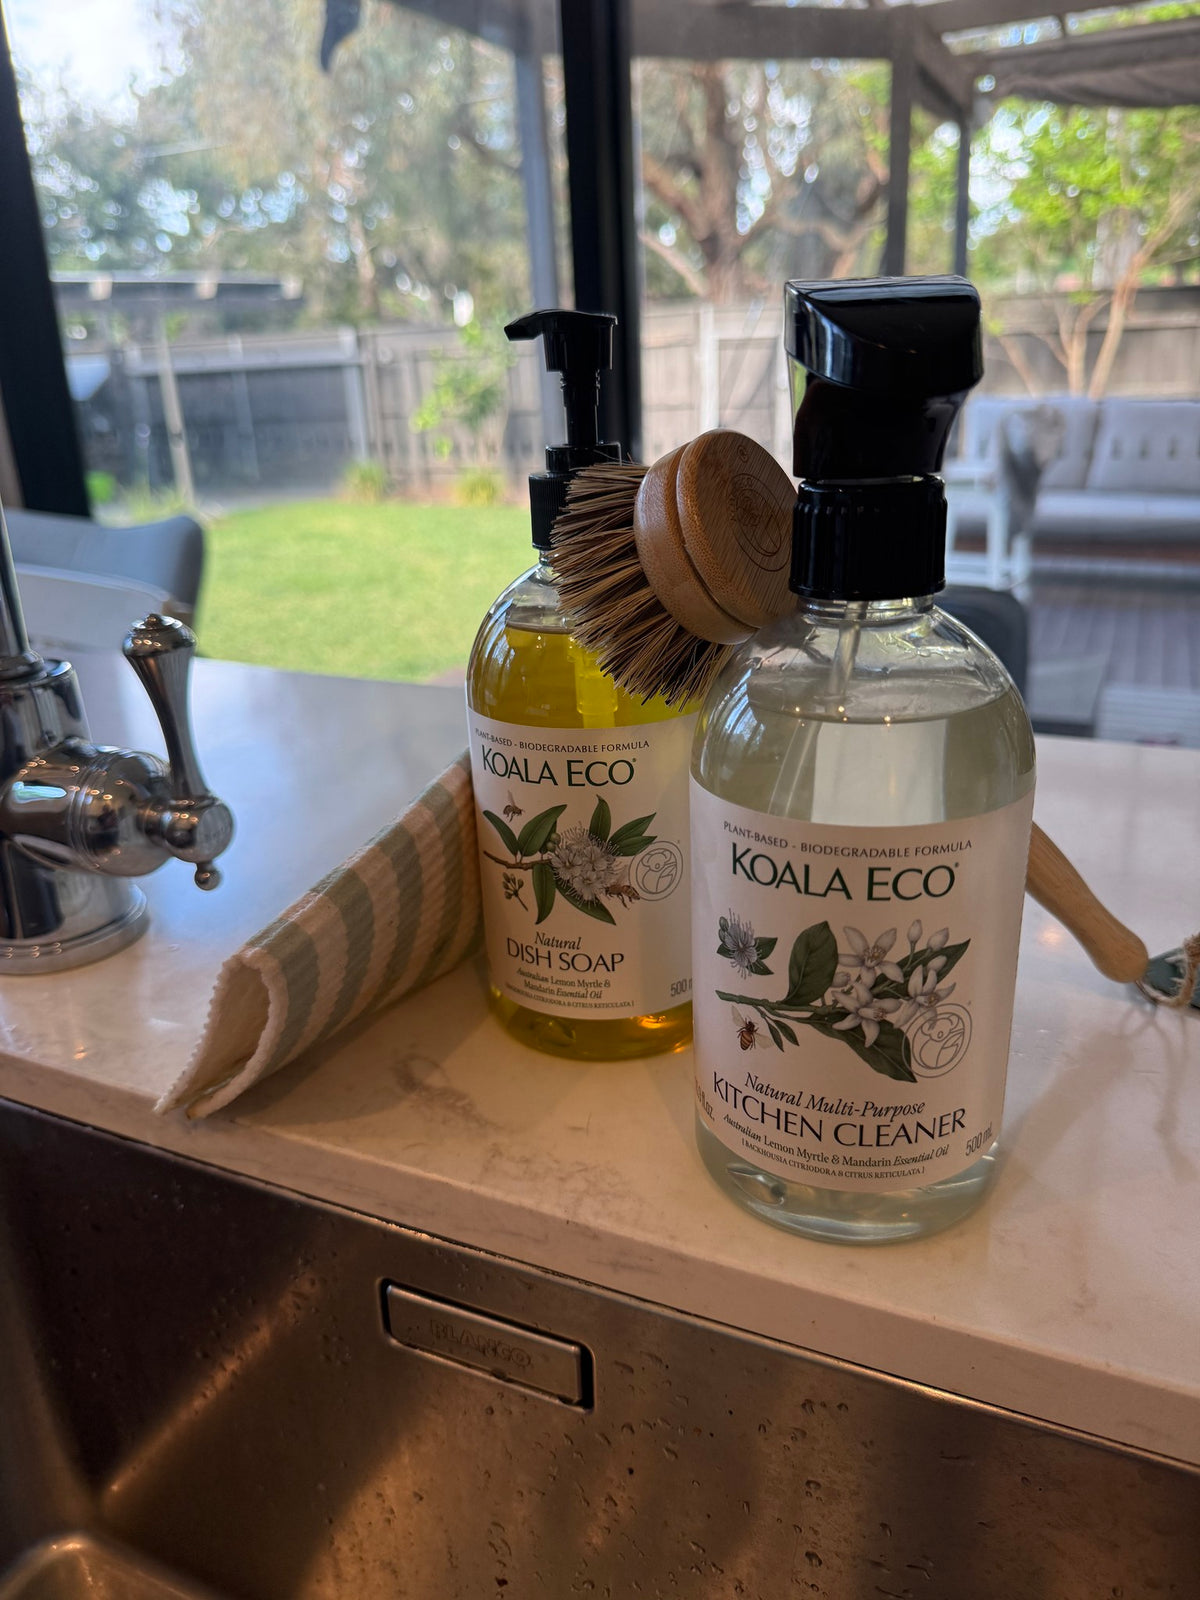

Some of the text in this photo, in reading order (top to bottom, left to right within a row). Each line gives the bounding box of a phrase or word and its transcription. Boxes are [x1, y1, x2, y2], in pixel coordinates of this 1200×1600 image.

[475, 728, 512, 747] PLANT-BASED
[519, 741, 598, 753] BIODEGRADABLE
[601, 740, 650, 751] FORMULA
[482, 745, 558, 786] KOALA
[723, 820, 788, 848] PLANT-BASED
[801, 842, 910, 858] BIODEGRADABLE
[914, 840, 973, 856] FORMULA
[732, 842, 852, 901] KOALA
[506, 937, 625, 973] DISH SOAP
[534, 931, 582, 951] Natural
[516, 967, 611, 992] Australian Lemon Myrtle &
[523, 979, 556, 995] Mandarin
[556, 989, 589, 999] Essential
[589, 990, 603, 999] Oil
[670, 978, 687, 997] 500
[713, 1071, 822, 1142] KITCHEN
[834, 1108, 966, 1147] CLEANER
[745, 1072, 925, 1122] Natural Multi-Purpose
[724, 1114, 950, 1167] Australian Lemon Myrtle & Mandarin Essential Oil
[965, 1132, 983, 1157] 500
[788, 1159, 836, 1177] CITRIODORA
[844, 1171, 873, 1179] CITRUS
[874, 1168, 920, 1179] RETICULATA
